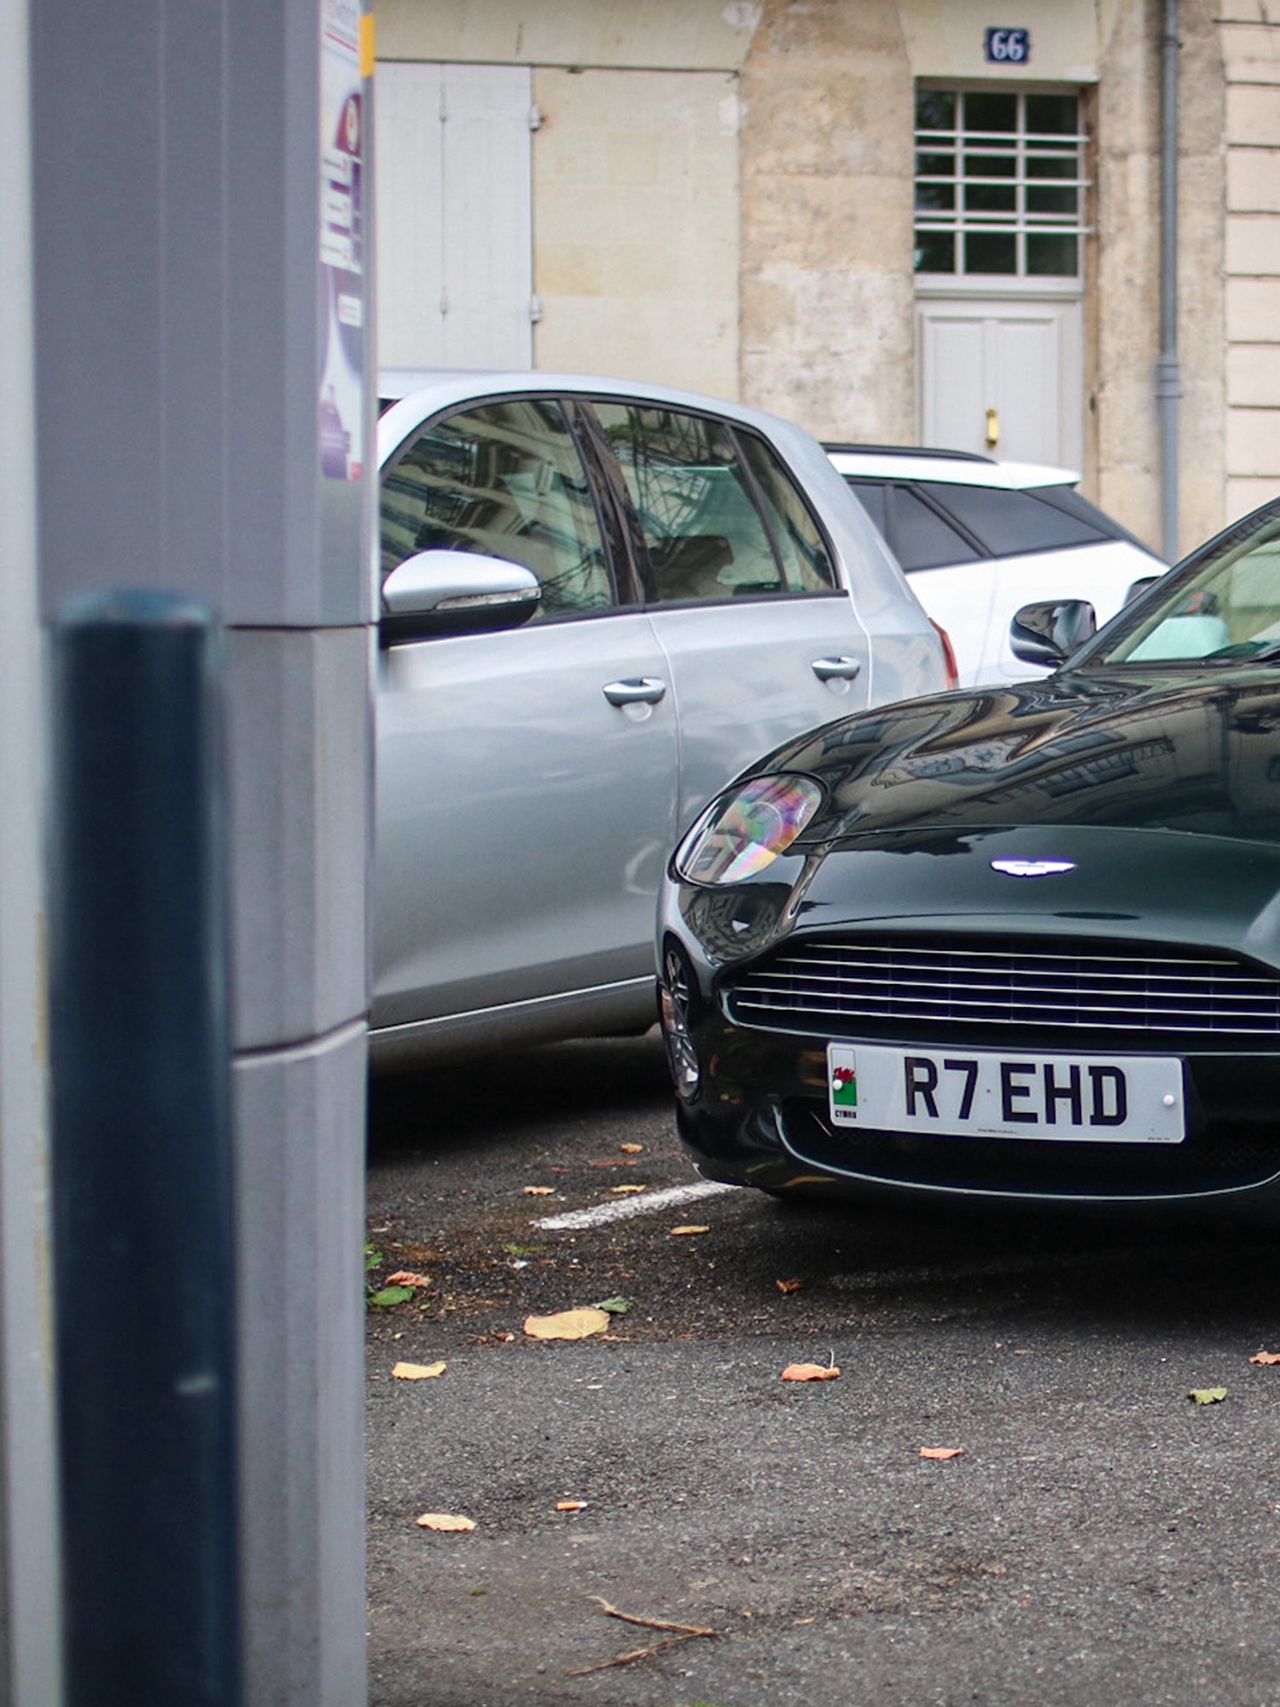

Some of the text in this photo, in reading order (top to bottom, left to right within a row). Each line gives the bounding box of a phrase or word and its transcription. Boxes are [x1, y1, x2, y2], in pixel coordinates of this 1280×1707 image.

[992, 30, 1025, 61] 66
[904, 1056, 1128, 1127] R7 EHD
